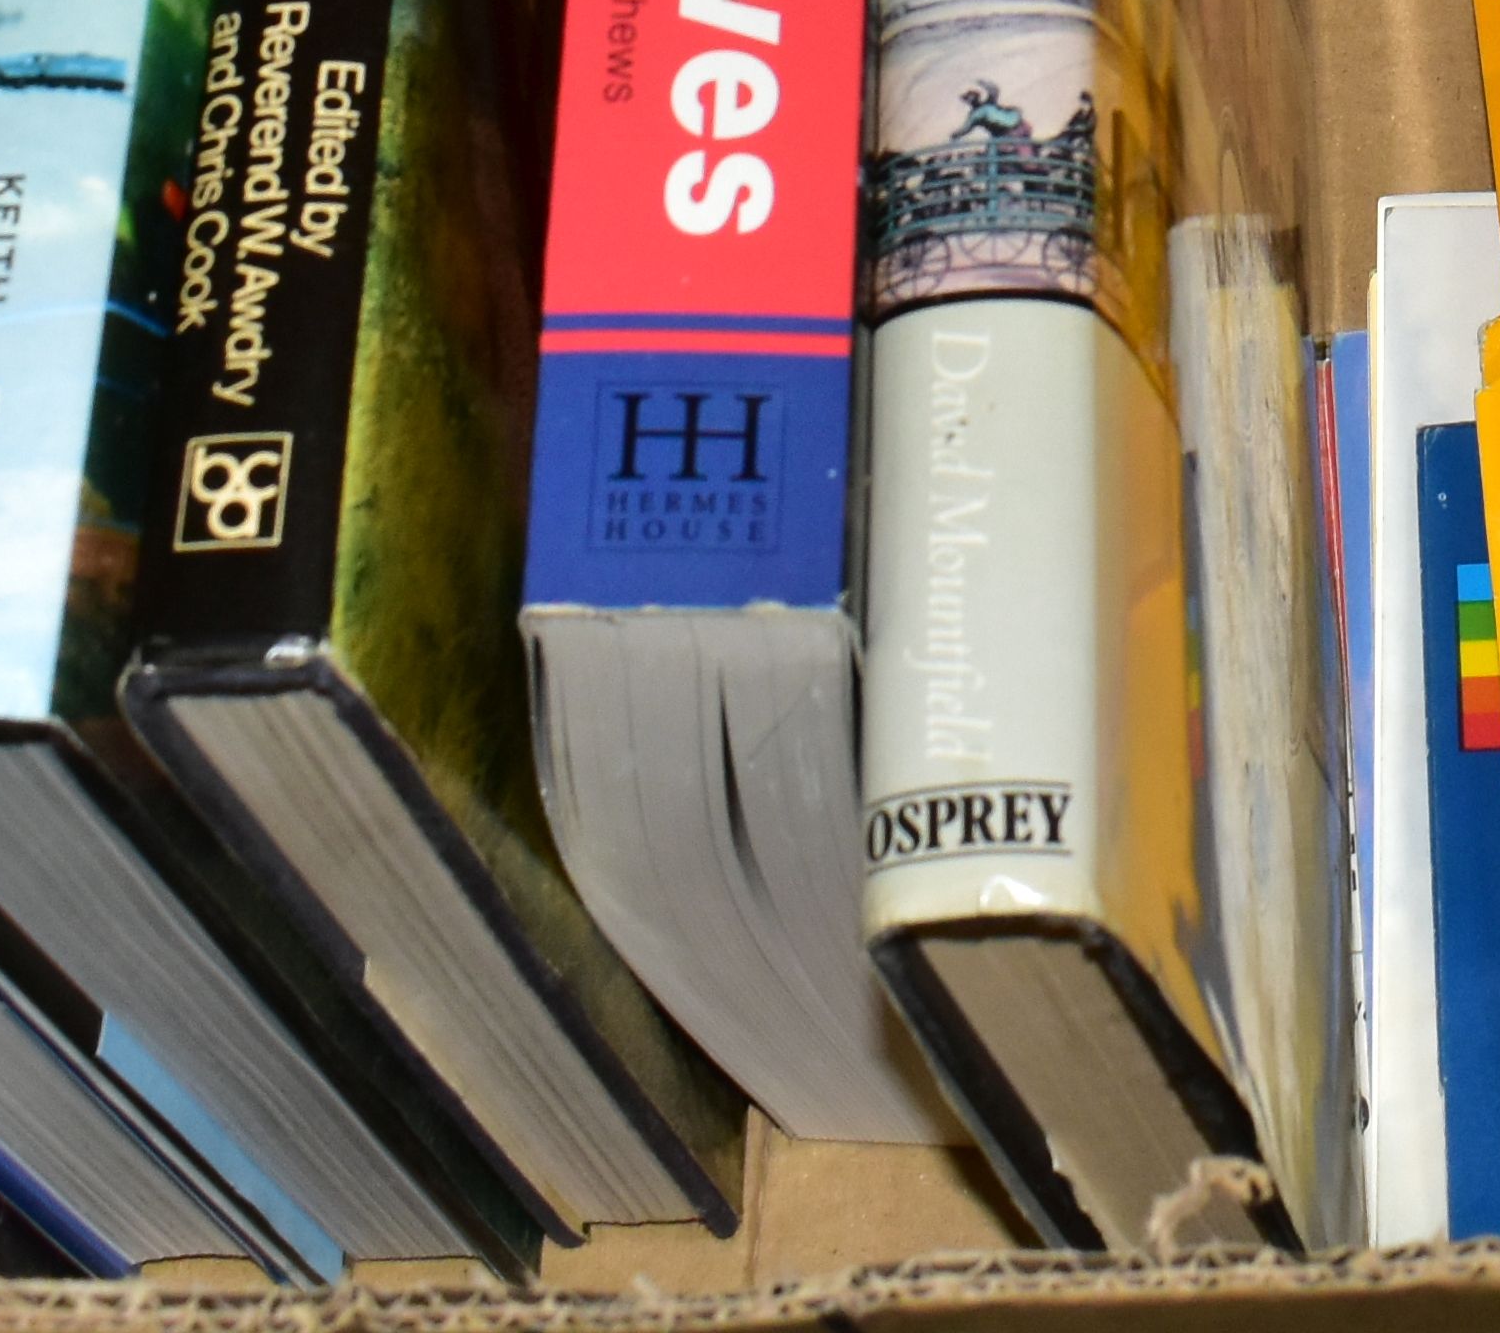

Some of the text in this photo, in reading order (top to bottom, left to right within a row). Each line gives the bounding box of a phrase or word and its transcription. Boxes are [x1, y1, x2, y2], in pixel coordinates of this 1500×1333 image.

[176, 11, 242, 333] and Chris Cook
[241, 0, 312, 202] Reverend
[290, 58, 366, 259] Edited by
[211, 264, 281, 408] Awdry
[603, 521, 766, 543] HOUSE
[606, 491, 771, 515] HERMES
[925, 330, 995, 765] David Mountfield
[867, 792, 1072, 863] OSPREY
